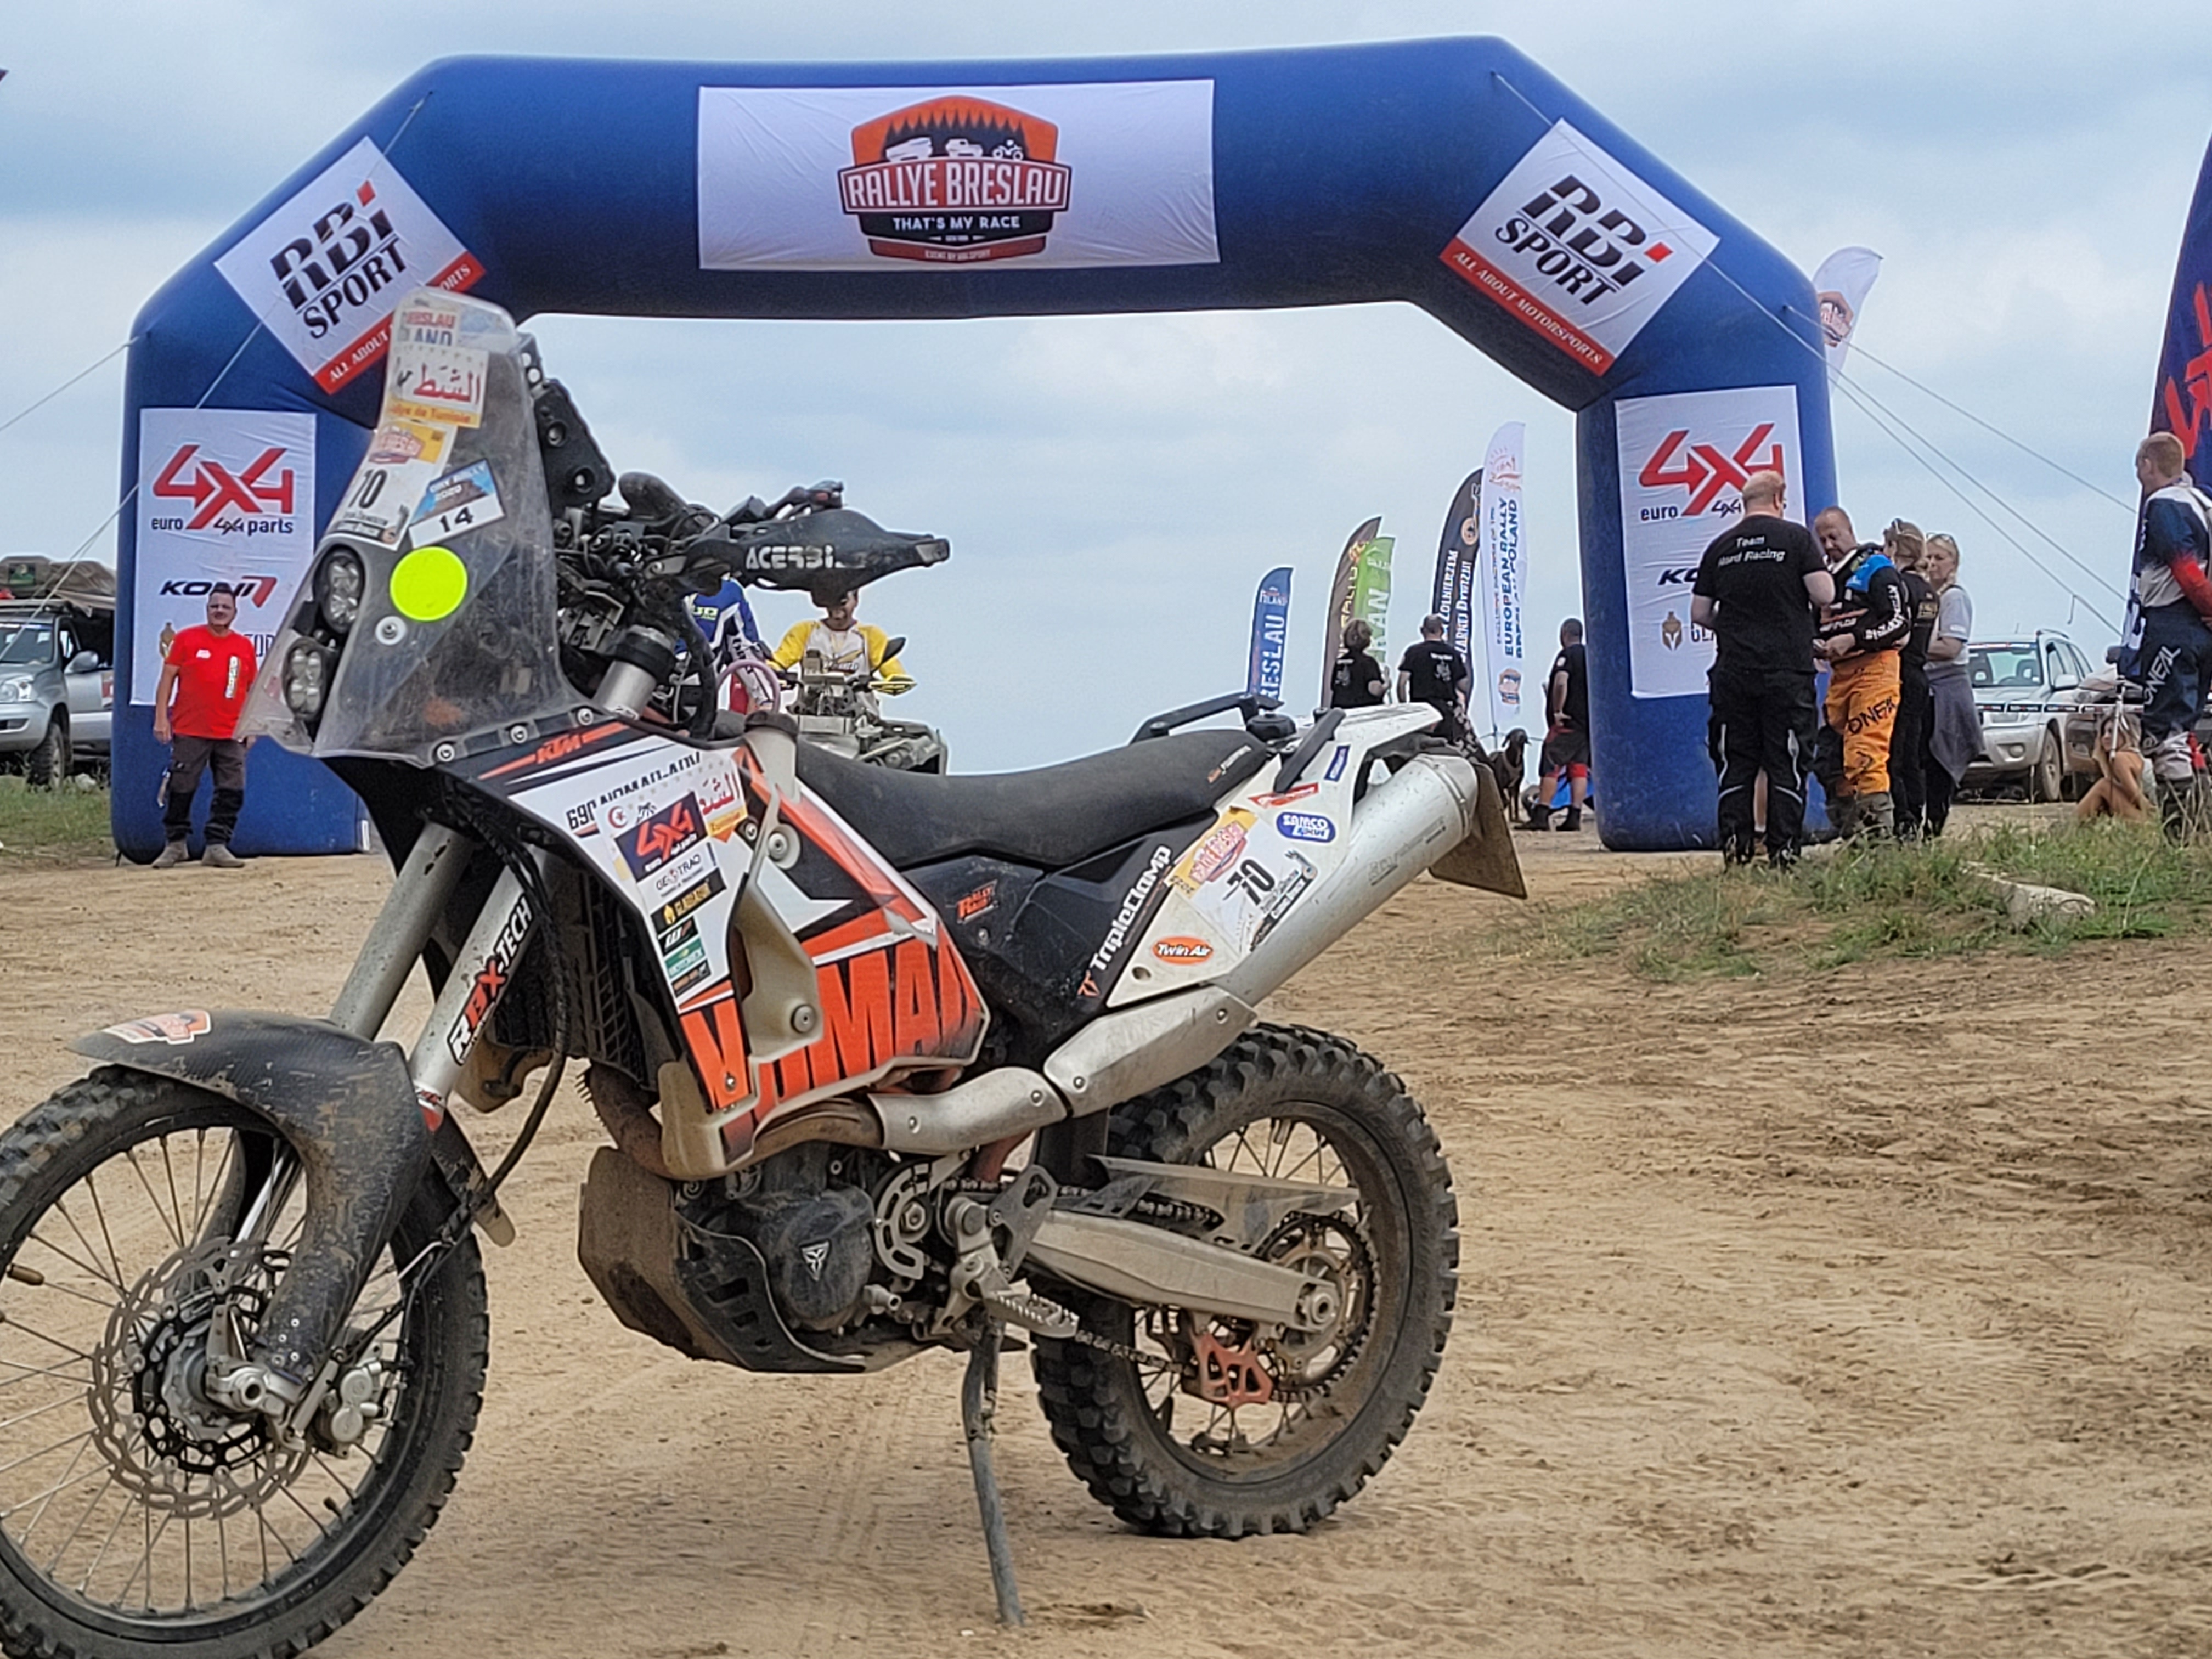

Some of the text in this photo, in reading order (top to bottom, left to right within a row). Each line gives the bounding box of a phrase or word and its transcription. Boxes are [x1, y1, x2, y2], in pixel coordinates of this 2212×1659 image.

[848, 162, 1063, 207] RALLYE BRESLAU
[893, 216, 1020, 232] THAT'S MY RACE
[1494, 217, 1617, 306] SPORT
[303, 238, 407, 340] SPORT
[1454, 251, 1603, 364] ALL ABOUT MOTORSPORTS
[329, 360, 350, 382] ALL
[352, 331, 389, 364] ABOUT
[151, 517, 184, 531] euro
[247, 517, 294, 537] parts
[440, 506, 474, 533] 14
[1641, 506, 1678, 521] euro
[1736, 536, 1765, 548] Team
[1743, 548, 1786, 562] Racing
[1498, 496, 1514, 657] EUROPEAN RALLY
[537, 733, 582, 765] KTM
[1226, 859, 1275, 906] 70
[1157, 943, 1189, 956] Twin
